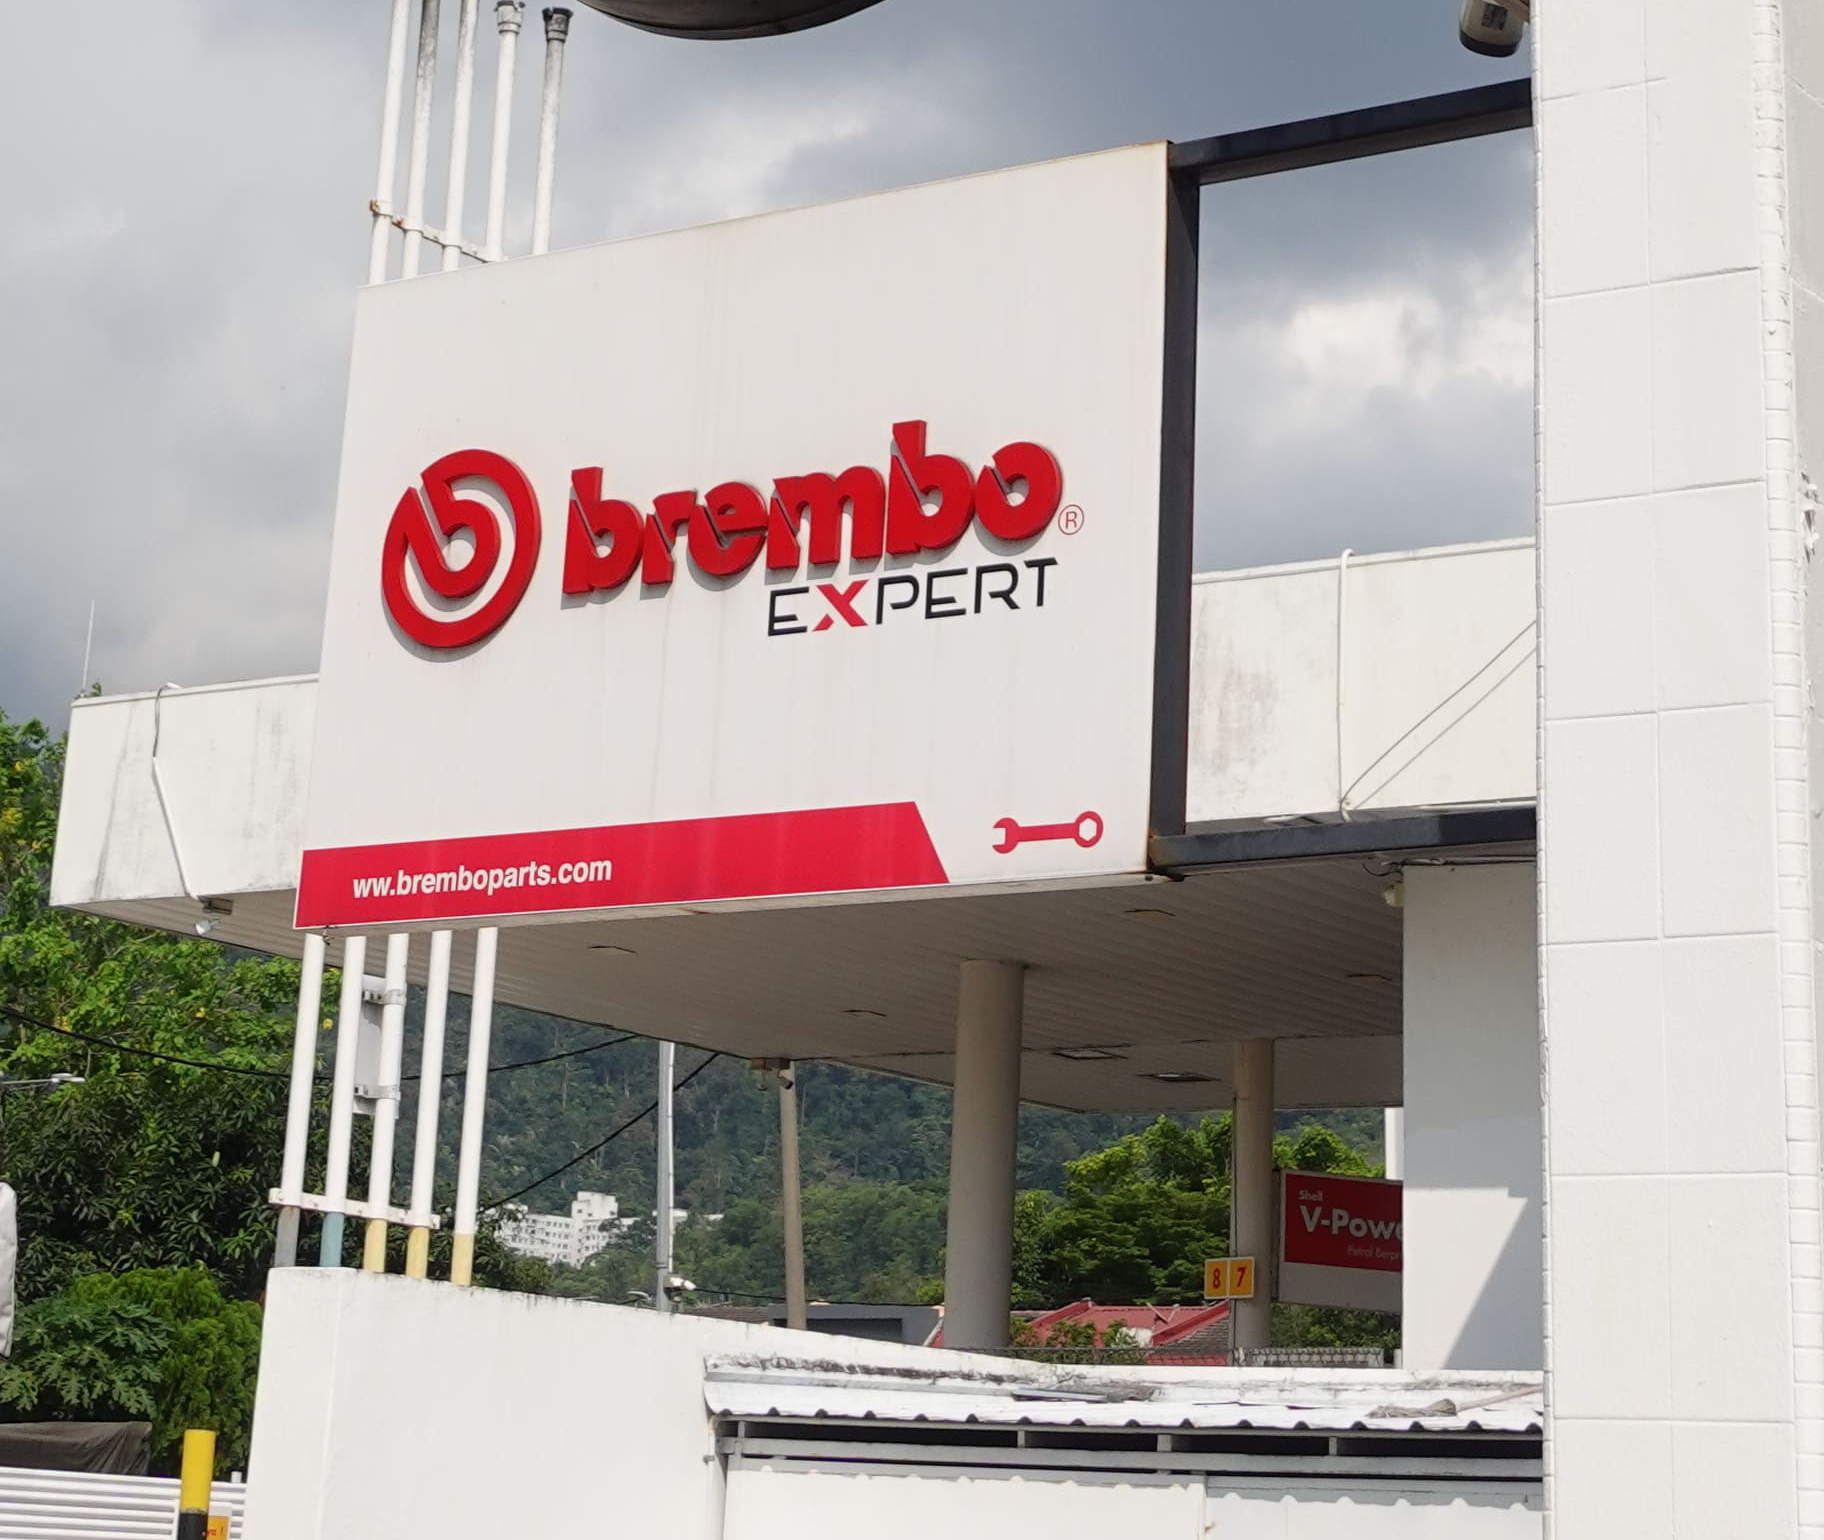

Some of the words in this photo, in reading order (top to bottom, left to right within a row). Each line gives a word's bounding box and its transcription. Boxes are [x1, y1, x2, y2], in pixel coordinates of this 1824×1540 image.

[562, 419, 1063, 597] brembo
[767, 557, 1060, 637] EXPERT
[1297, 1189, 1324, 1202] Shell
[1212, 1267, 1221, 1289] 8
[1236, 1266, 1247, 1288] 7
